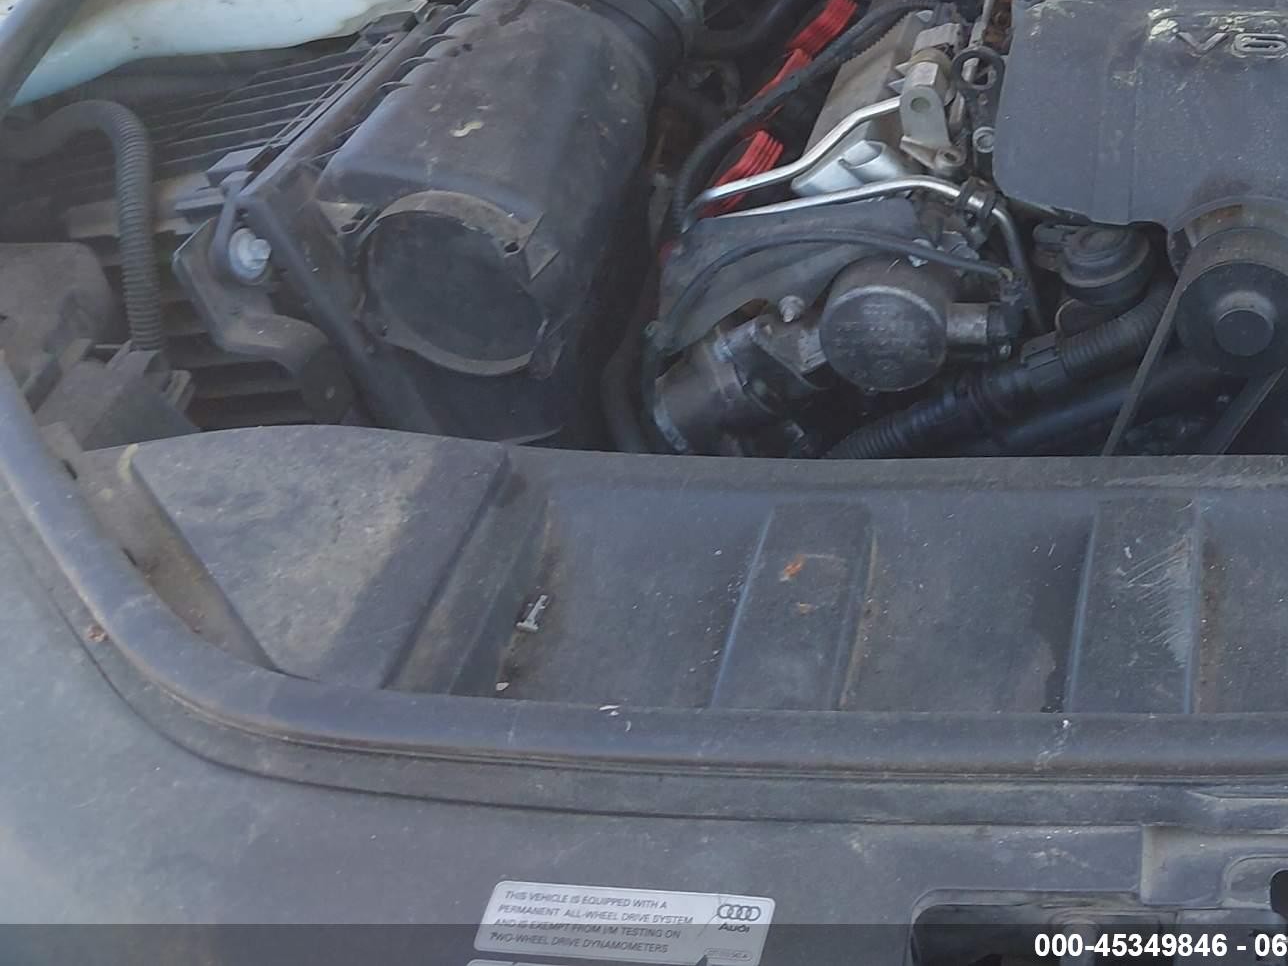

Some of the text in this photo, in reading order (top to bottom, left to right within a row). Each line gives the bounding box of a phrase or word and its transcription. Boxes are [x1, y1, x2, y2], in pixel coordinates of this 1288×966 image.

[1178, 32, 1288, 53] V6
[504, 891, 668, 910] THIS VEHICLE IS EQUIPPED WITH A
[497, 904, 695, 925] PERMANENT ALL-WHEEL DRIVE SYSTEM
[493, 918, 517, 928] AND
[529, 920, 570, 932] EXEMPT
[571, 923, 602, 934] FROM
[621, 926, 663, 938] TESTING
[664, 929, 682, 939] ON
[717, 921, 751, 933] Audi
[550, 936, 581, 948] DRIVE
[582, 938, 670, 953] DYNAMOMETERS
